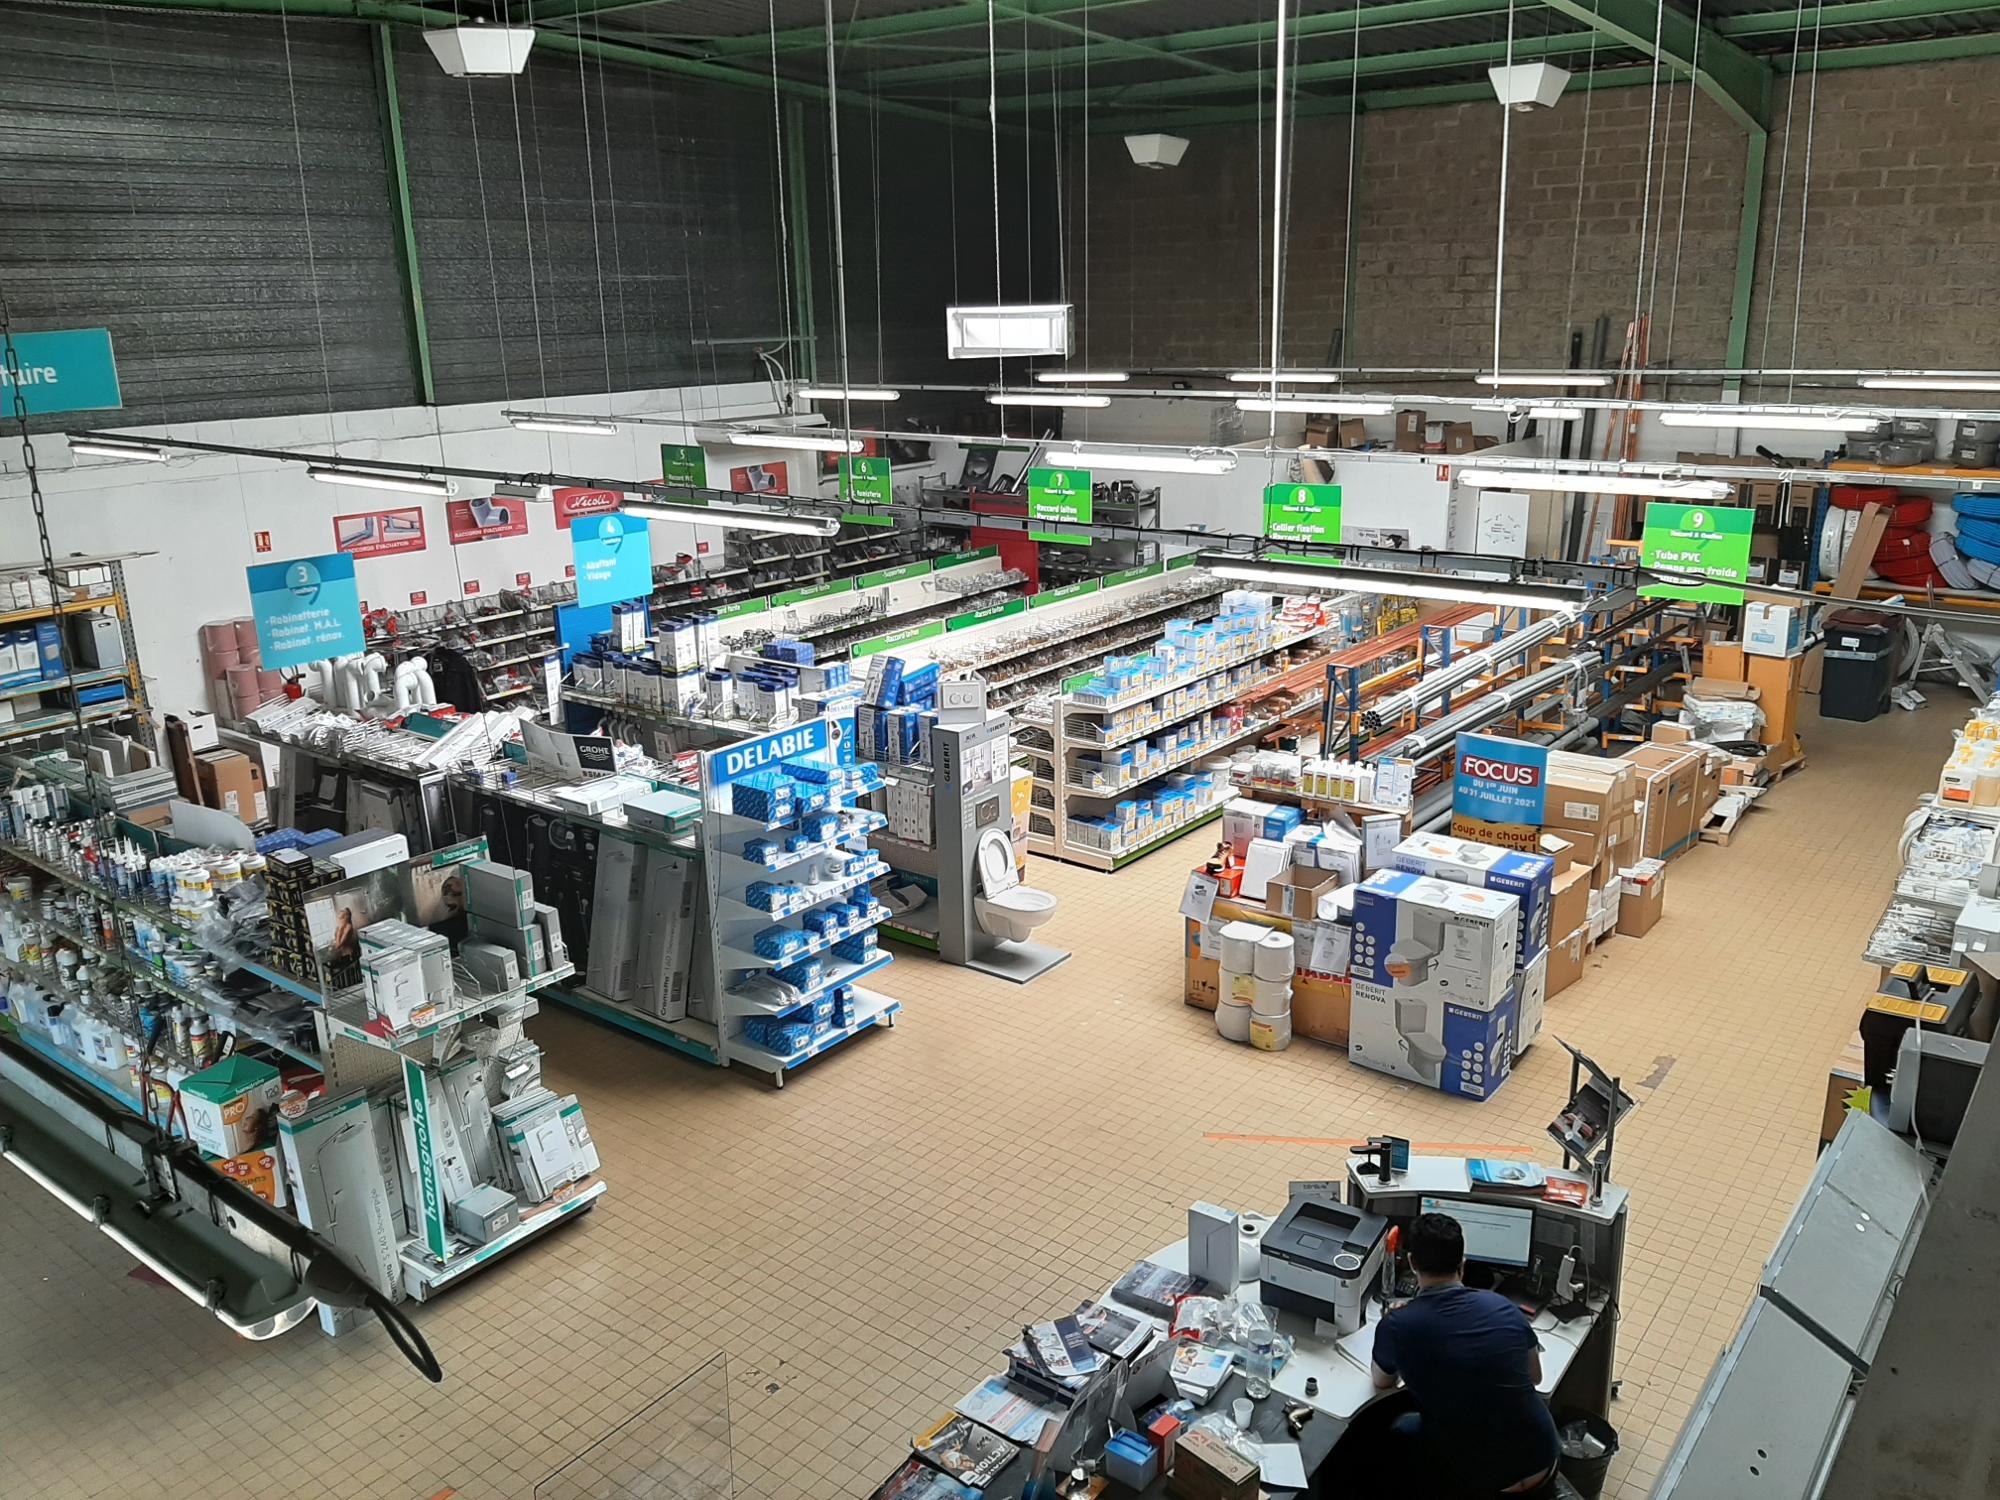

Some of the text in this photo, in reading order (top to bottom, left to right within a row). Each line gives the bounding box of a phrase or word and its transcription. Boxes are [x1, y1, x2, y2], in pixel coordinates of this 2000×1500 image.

[861, 462, 867, 473] 6
[1298, 489, 1306, 503] 8
[1693, 512, 1704, 528] 9
[1681, 551, 1701, 562] PVC
[297, 567, 308, 583] 3
[1707, 566, 1738, 578] froide
[580, 745, 610, 755] GROHE
[726, 728, 815, 776] DELABIE
[943, 742, 951, 783] GEBERIT
[1464, 756, 1534, 785] FOCUS
[1472, 779, 1485, 788] DU
[1498, 784, 1519, 795] JUIN
[1458, 785, 1468, 795] AU
[1478, 790, 1513, 806] JUILLET
[1515, 798, 1536, 808] 2021
[1452, 822, 1476, 837] Coup
[1478, 827, 1493, 838] de
[1496, 830, 1537, 842] chaud
[442, 844, 480, 860] hansgrohe
[1496, 877, 1525, 888] GEBERIT
[1355, 982, 1387, 996] GEBERIT
[1355, 991, 1387, 1004] RENOVA
[1453, 1008, 1484, 1021] GEBERIT
[190, 1106, 212, 1129] 120
[223, 1103, 245, 1118] PRO
[412, 1098, 438, 1222] hansgrohe
